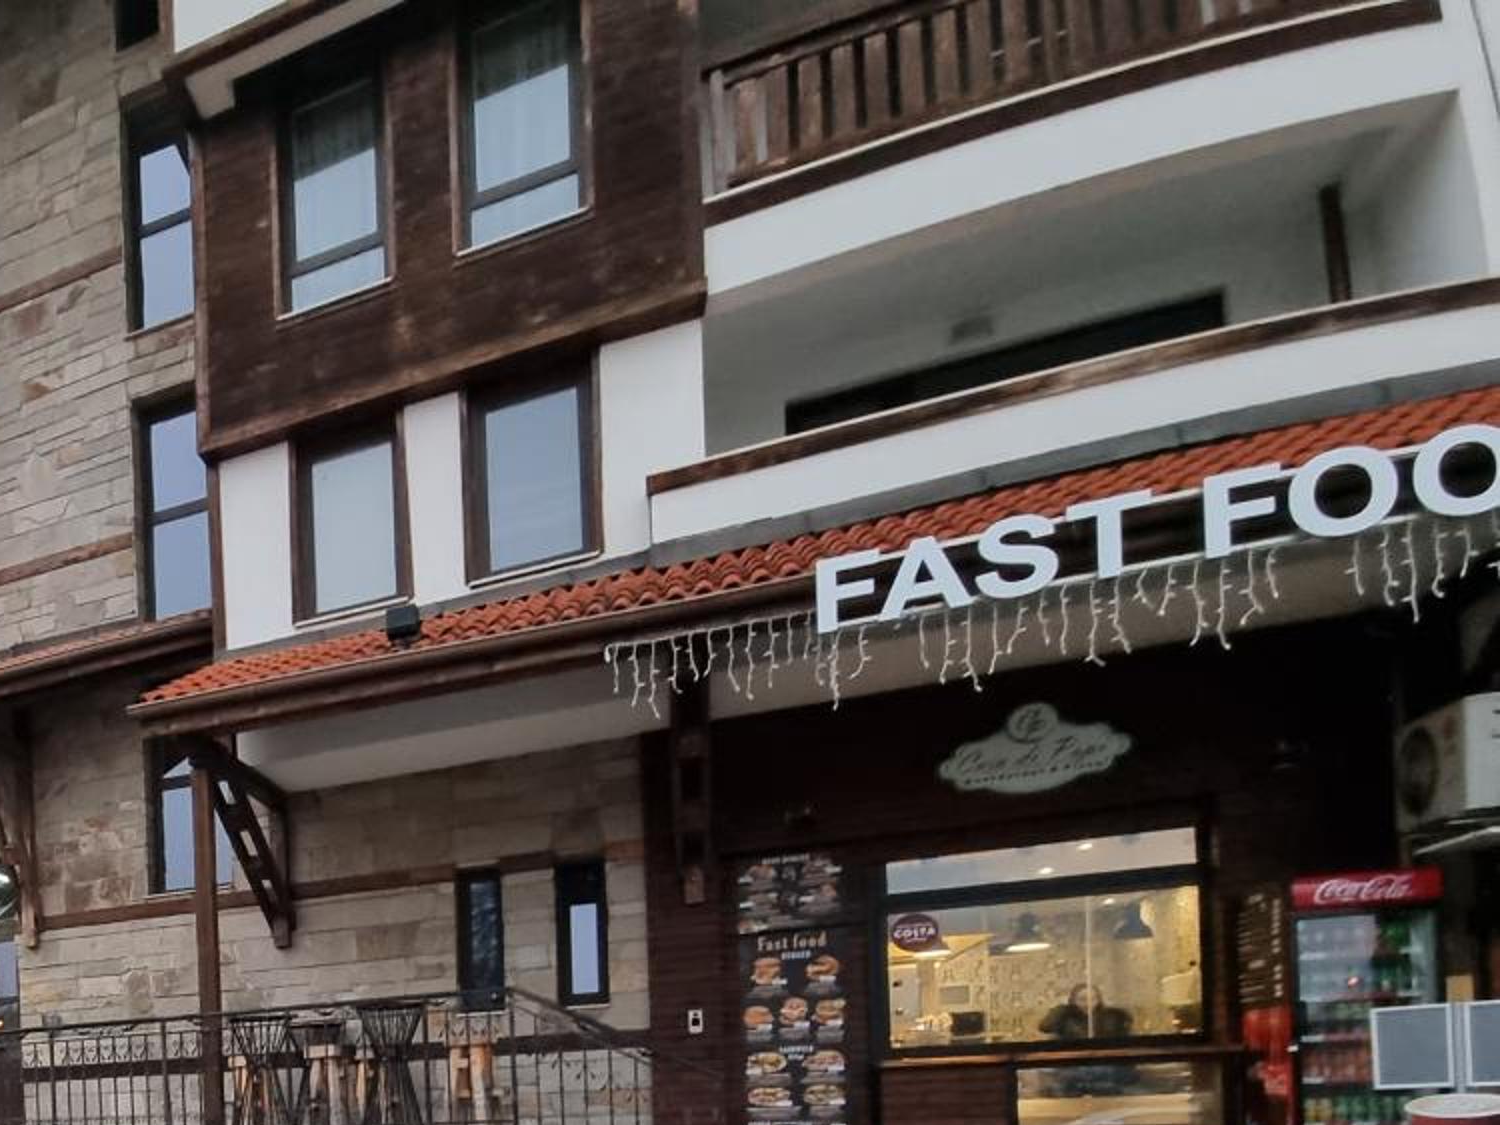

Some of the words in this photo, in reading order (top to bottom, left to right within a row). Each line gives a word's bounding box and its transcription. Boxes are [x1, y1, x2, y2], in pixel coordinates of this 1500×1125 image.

[816, 489, 1155, 634] FAST
[757, 936, 789, 952] Fast
[792, 930, 828, 949] food
